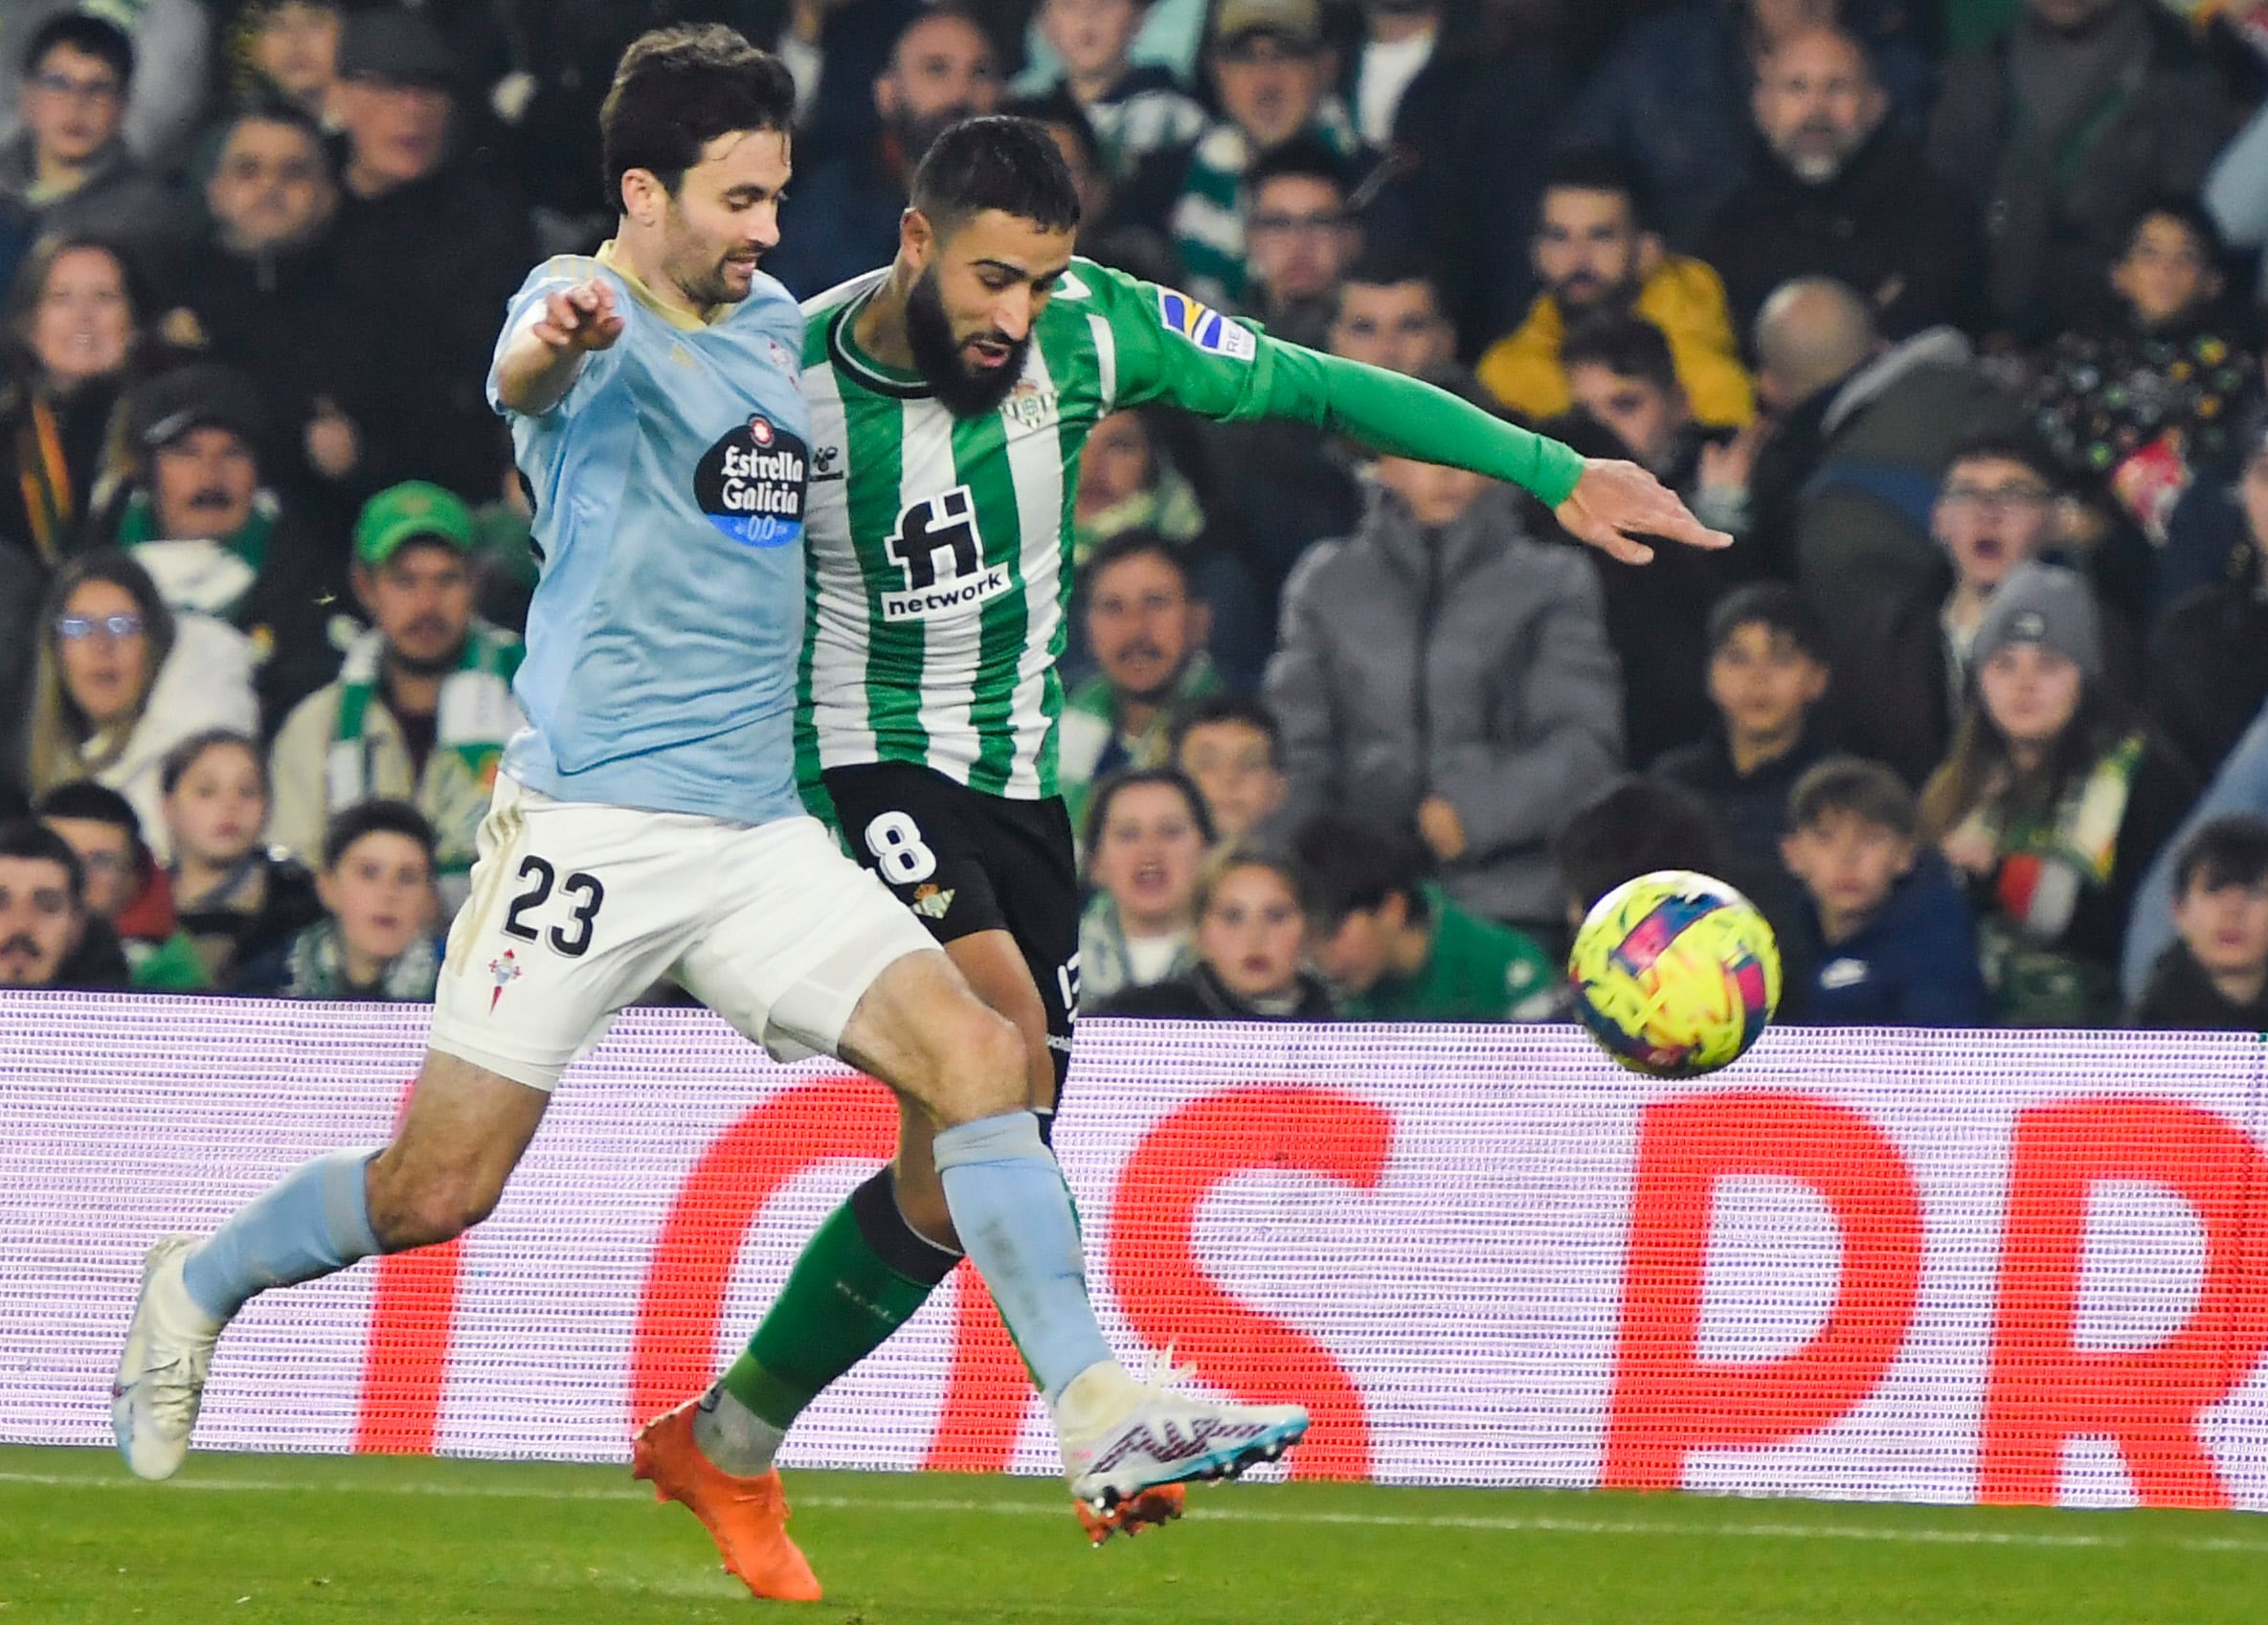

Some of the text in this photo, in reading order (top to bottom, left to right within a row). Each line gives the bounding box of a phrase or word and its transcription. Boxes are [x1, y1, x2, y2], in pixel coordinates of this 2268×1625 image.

[721, 444, 804, 483] Estrella
[722, 477, 798, 514] Galicia
[891, 491, 978, 590] fi
[888, 573, 1002, 616] network
[865, 810, 937, 885] 8
[501, 854, 605, 958] 23
